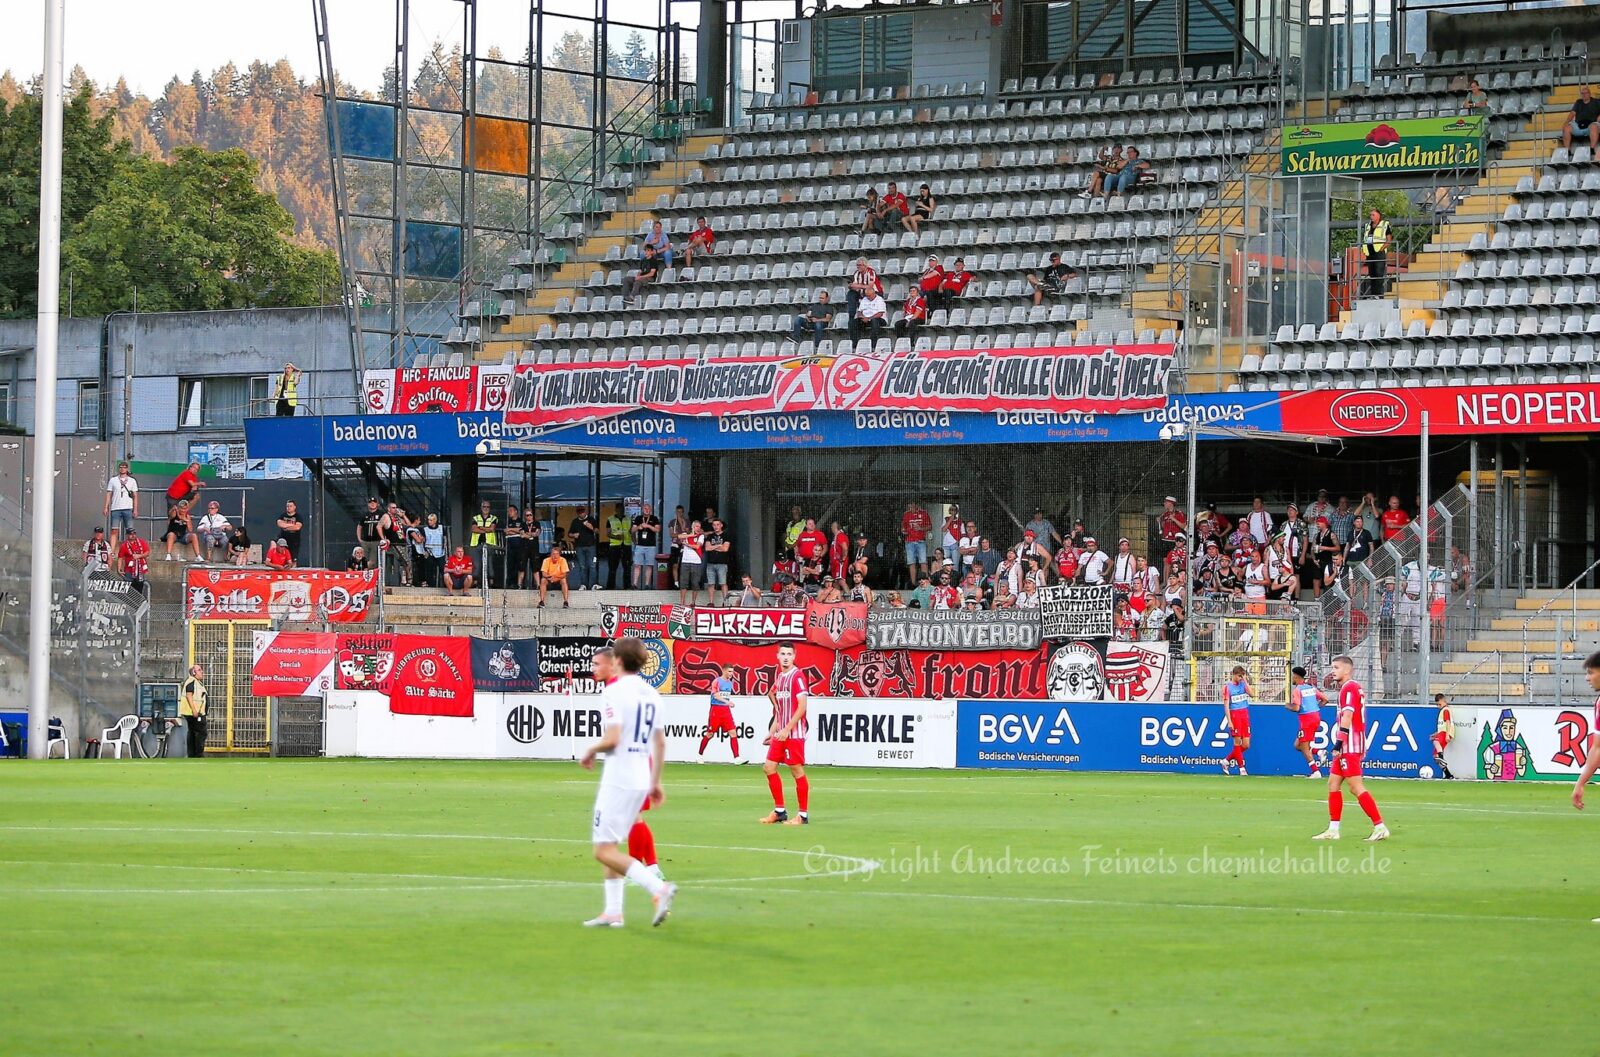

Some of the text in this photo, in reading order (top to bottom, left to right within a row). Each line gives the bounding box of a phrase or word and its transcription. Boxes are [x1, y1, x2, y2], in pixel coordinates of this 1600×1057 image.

[1285, 143, 1478, 173] Schwarzwaldmilch
[401, 368, 419, 382] HFC
[427, 366, 471, 381] FANCLUB
[484, 376, 504, 386] HFC
[883, 353, 924, 395] FÜR
[922, 355, 989, 395] CHEMIE
[993, 357, 1050, 396] HALLE
[1055, 357, 1086, 396] UM
[1089, 352, 1119, 396] DIE
[368, 380, 386, 388] HFC
[513, 360, 777, 408] MIT URLAUBSZEIT UND BÜRGERGELD
[1455, 391, 1600, 426] NEOPERL
[585, 416, 675, 435] badenova
[717, 415, 809, 432] badenova
[853, 410, 949, 428] badenova
[332, 420, 417, 441] badenova
[628, 605, 658, 615] SEKTION
[1042, 600, 1112, 613] BOYKOTTIEREN
[620, 613, 666, 624] MANSFELD
[695, 612, 805, 635] SURREALE
[1044, 613, 1112, 625] MONTAGSSPIELE
[622, 626, 662, 639] SÜDHARZ
[540, 642, 581, 658] Libertà
[862, 652, 881, 663] HFC
[393, 647, 462, 682] CLUBFREUNDE ANHALT
[538, 659, 580, 674] Chemie
[677, 647, 1046, 698] Saae front
[404, 685, 455, 698] Alte Säcke
[505, 705, 605, 744] AHP MER
[633, 703, 656, 743] 19
[979, 714, 1044, 744] BGV
[1140, 717, 1209, 747] BGV
[877, 750, 914, 759] BEWEGT
[979, 752, 1080, 765] Badische Versicherungen
[1140, 755, 1179, 764] Badische
